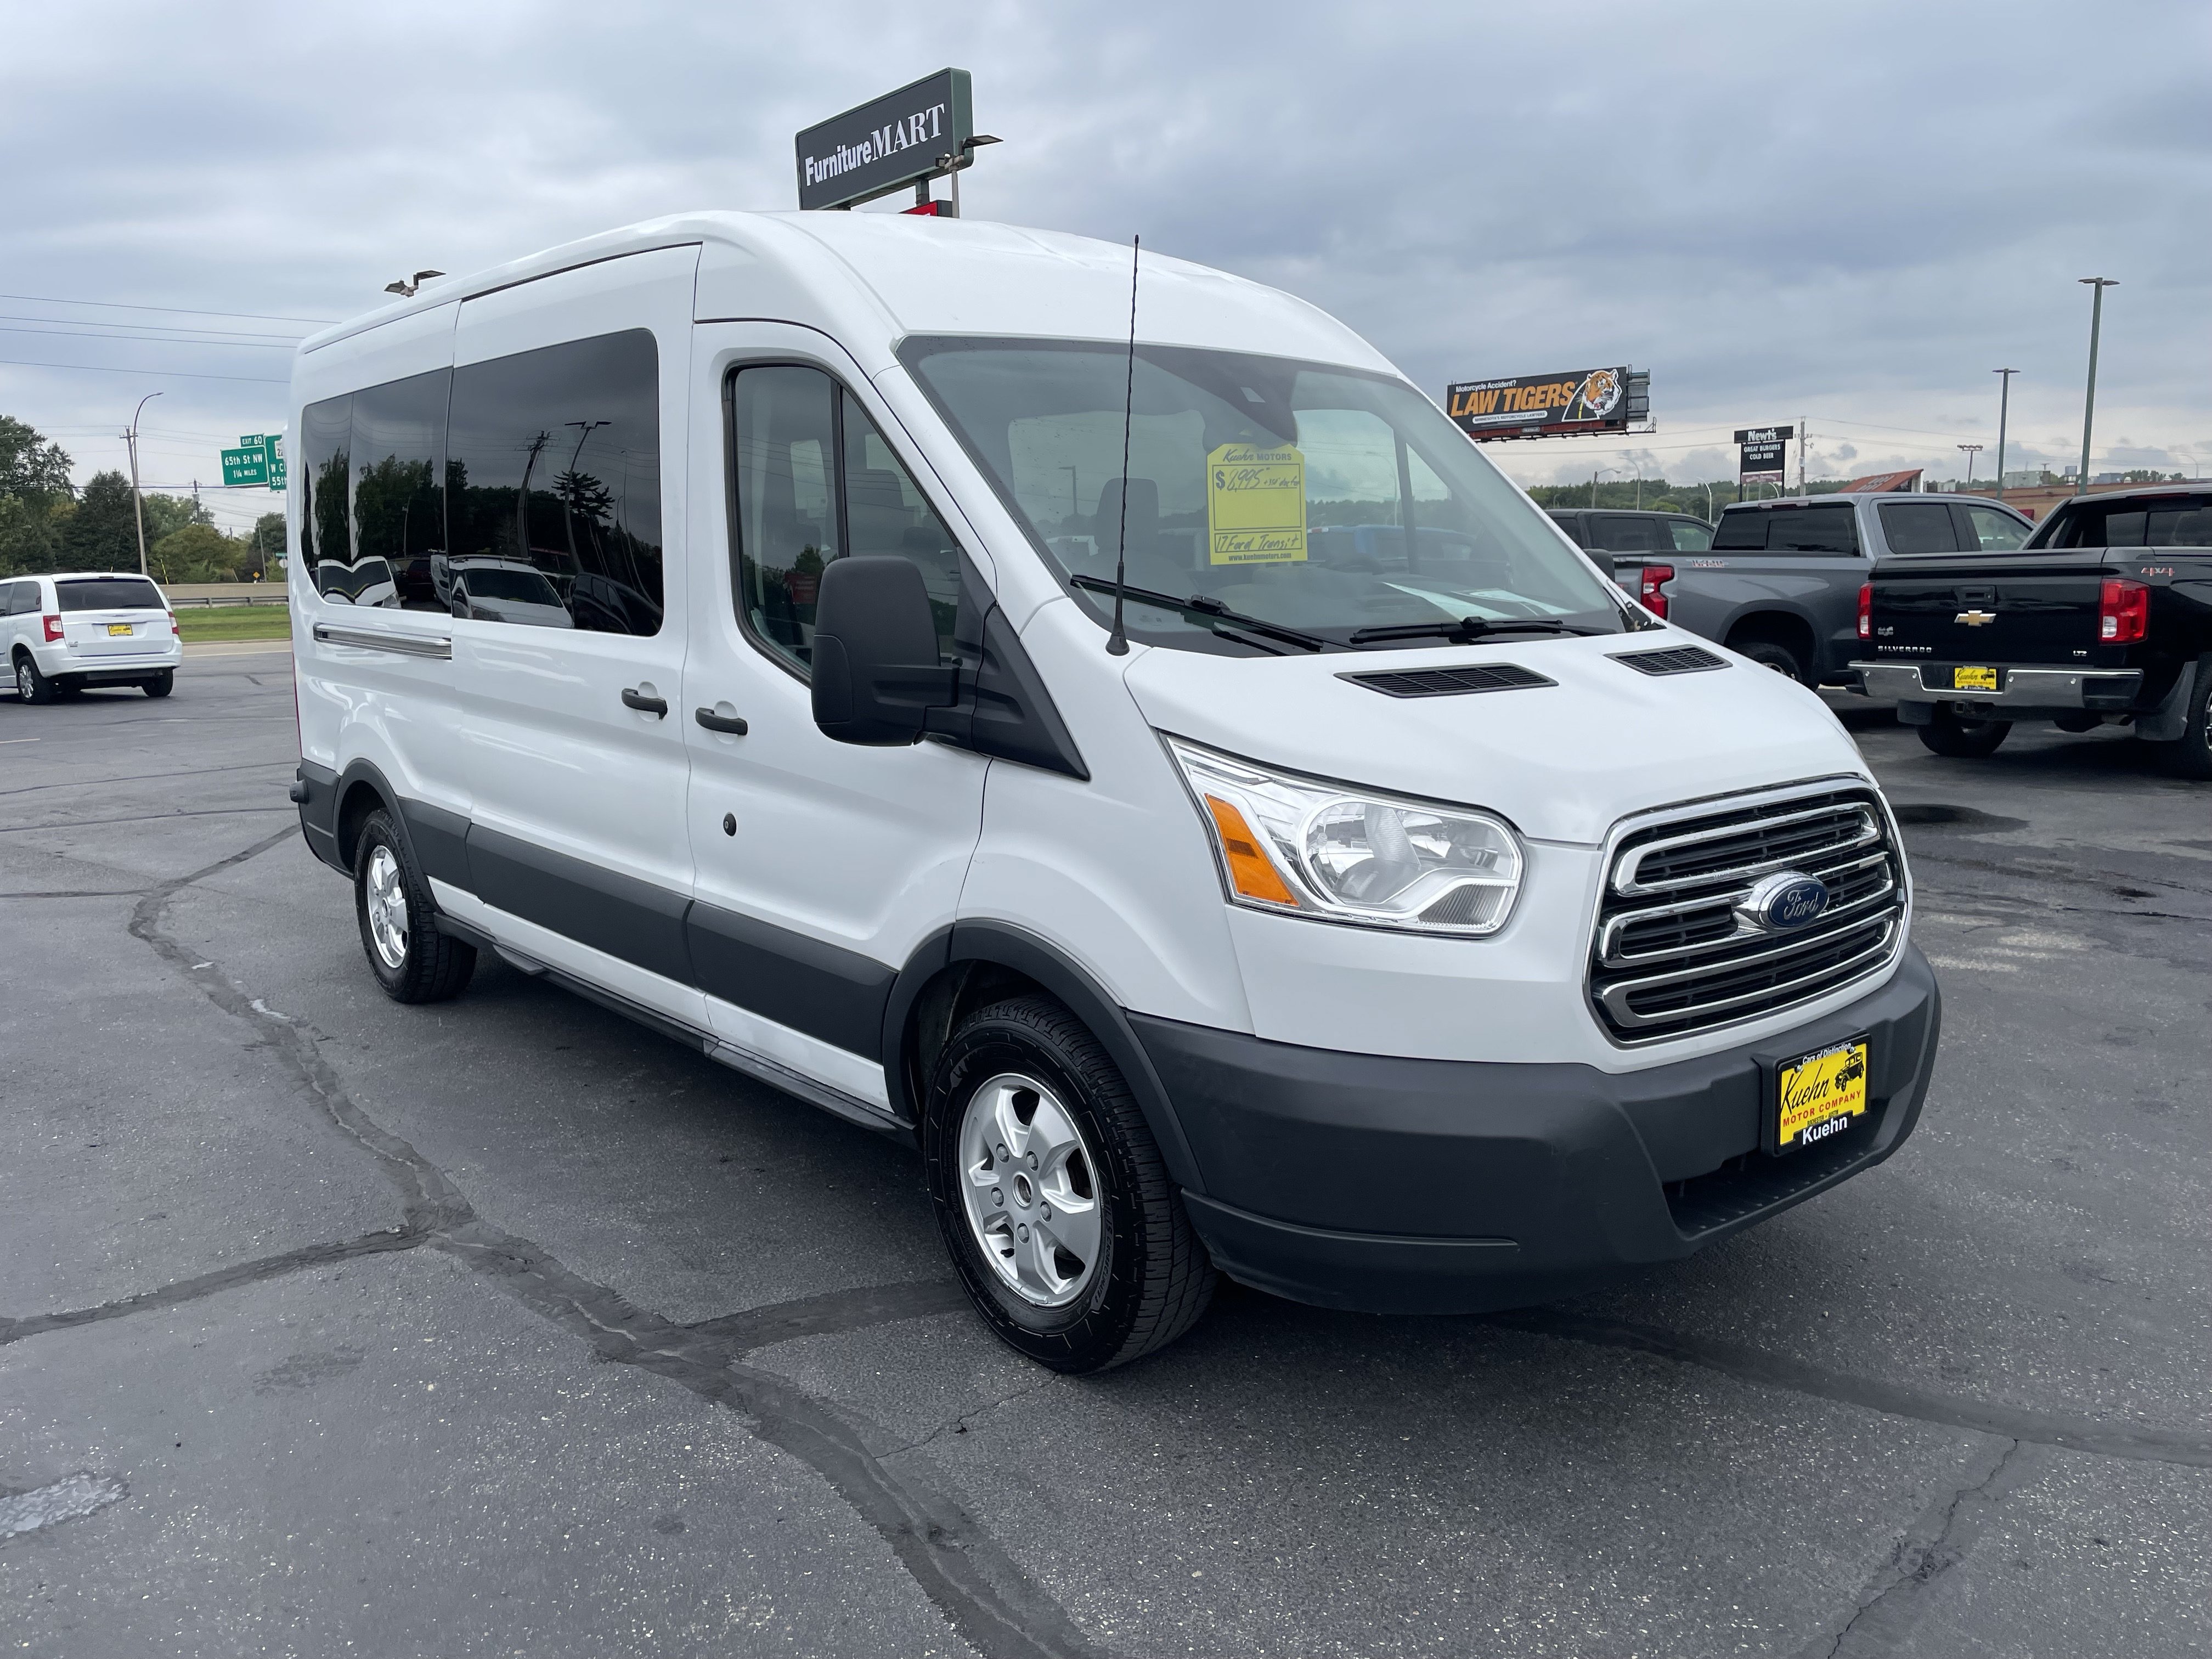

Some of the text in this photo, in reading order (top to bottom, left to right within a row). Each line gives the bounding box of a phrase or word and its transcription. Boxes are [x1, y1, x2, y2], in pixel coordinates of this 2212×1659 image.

[805, 103, 945, 186] FurnitureMART
[1455, 380, 1516, 392] Motorcycle Accident?
[1451, 381, 1576, 417] LAW TIGERS
[254, 436, 262, 444] 60
[1747, 428, 1777, 442] Newt's
[225, 454, 263, 466] 65th St NW
[1223, 448, 1255, 463] Kuehn
[270, 464, 276, 473] W
[1216, 533, 1299, 551] 17 Ford Transit
[1228, 552, 1292, 561] www.kuehnmotors.com
[1784, 887, 1820, 920] Ford
[1802, 1042, 1852, 1065] Cars of Distinction
[1781, 1063, 1830, 1115] Kuehn
[1783, 1090, 1861, 1127] MOTOR COMPANY
[1802, 1116, 1847, 1145] Kuehn
